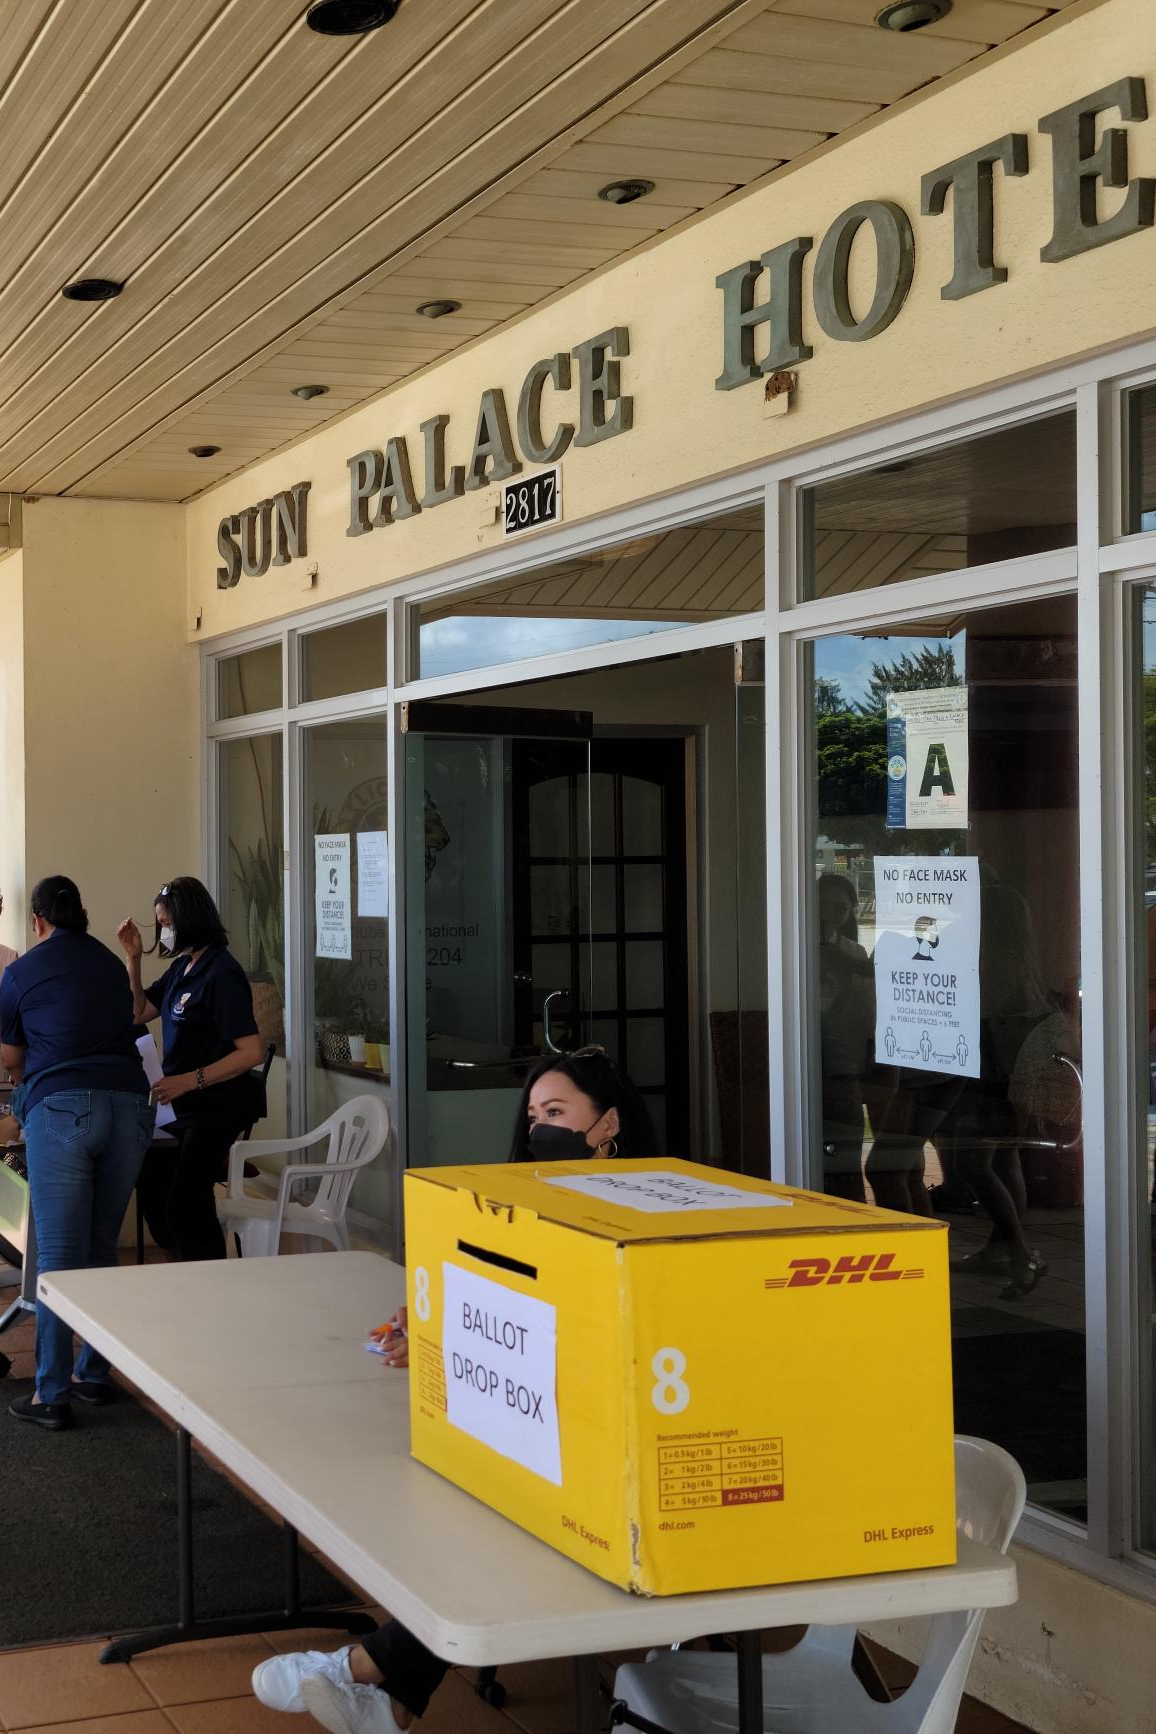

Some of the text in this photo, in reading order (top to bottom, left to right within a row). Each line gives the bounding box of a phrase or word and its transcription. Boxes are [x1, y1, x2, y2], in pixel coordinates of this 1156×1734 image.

[217, 76, 1156, 589] SUN PALACE HOTE
[506, 477, 557, 529] 2817
[919, 743, 956, 797] A
[883, 869, 967, 882] NO FACE MASK
[896, 892, 953, 905] NO ENTRY
[425, 924, 479, 937] national
[427, 947, 463, 966] 204
[891, 971, 957, 988] KEEP YOUR
[893, 987, 956, 1007] DISTANCE!
[897, 1006, 952, 1018] SOCIAL DISTANCING
[897, 1015, 916, 1023] PUBLIC
[917, 1017, 937, 1026] SPACES
[948, 1020, 960, 1028] FEET
[586, 1176, 707, 1206] DROP BOX
[646, 1177, 743, 1198] BALLOT
[786, 1253, 904, 1288] DHL
[415, 1266, 431, 1322] 8
[463, 1302, 529, 1355] BALLOT
[452, 1352, 499, 1397] DROP
[505, 1378, 544, 1424] BOX
[651, 1347, 691, 1415] 8
[657, 1429, 739, 1441] Recommended weight
[562, 1514, 611, 1552] DHL Expres
[658, 1520, 695, 1531] dhl.com
[863, 1525, 935, 1543] DHL Express
